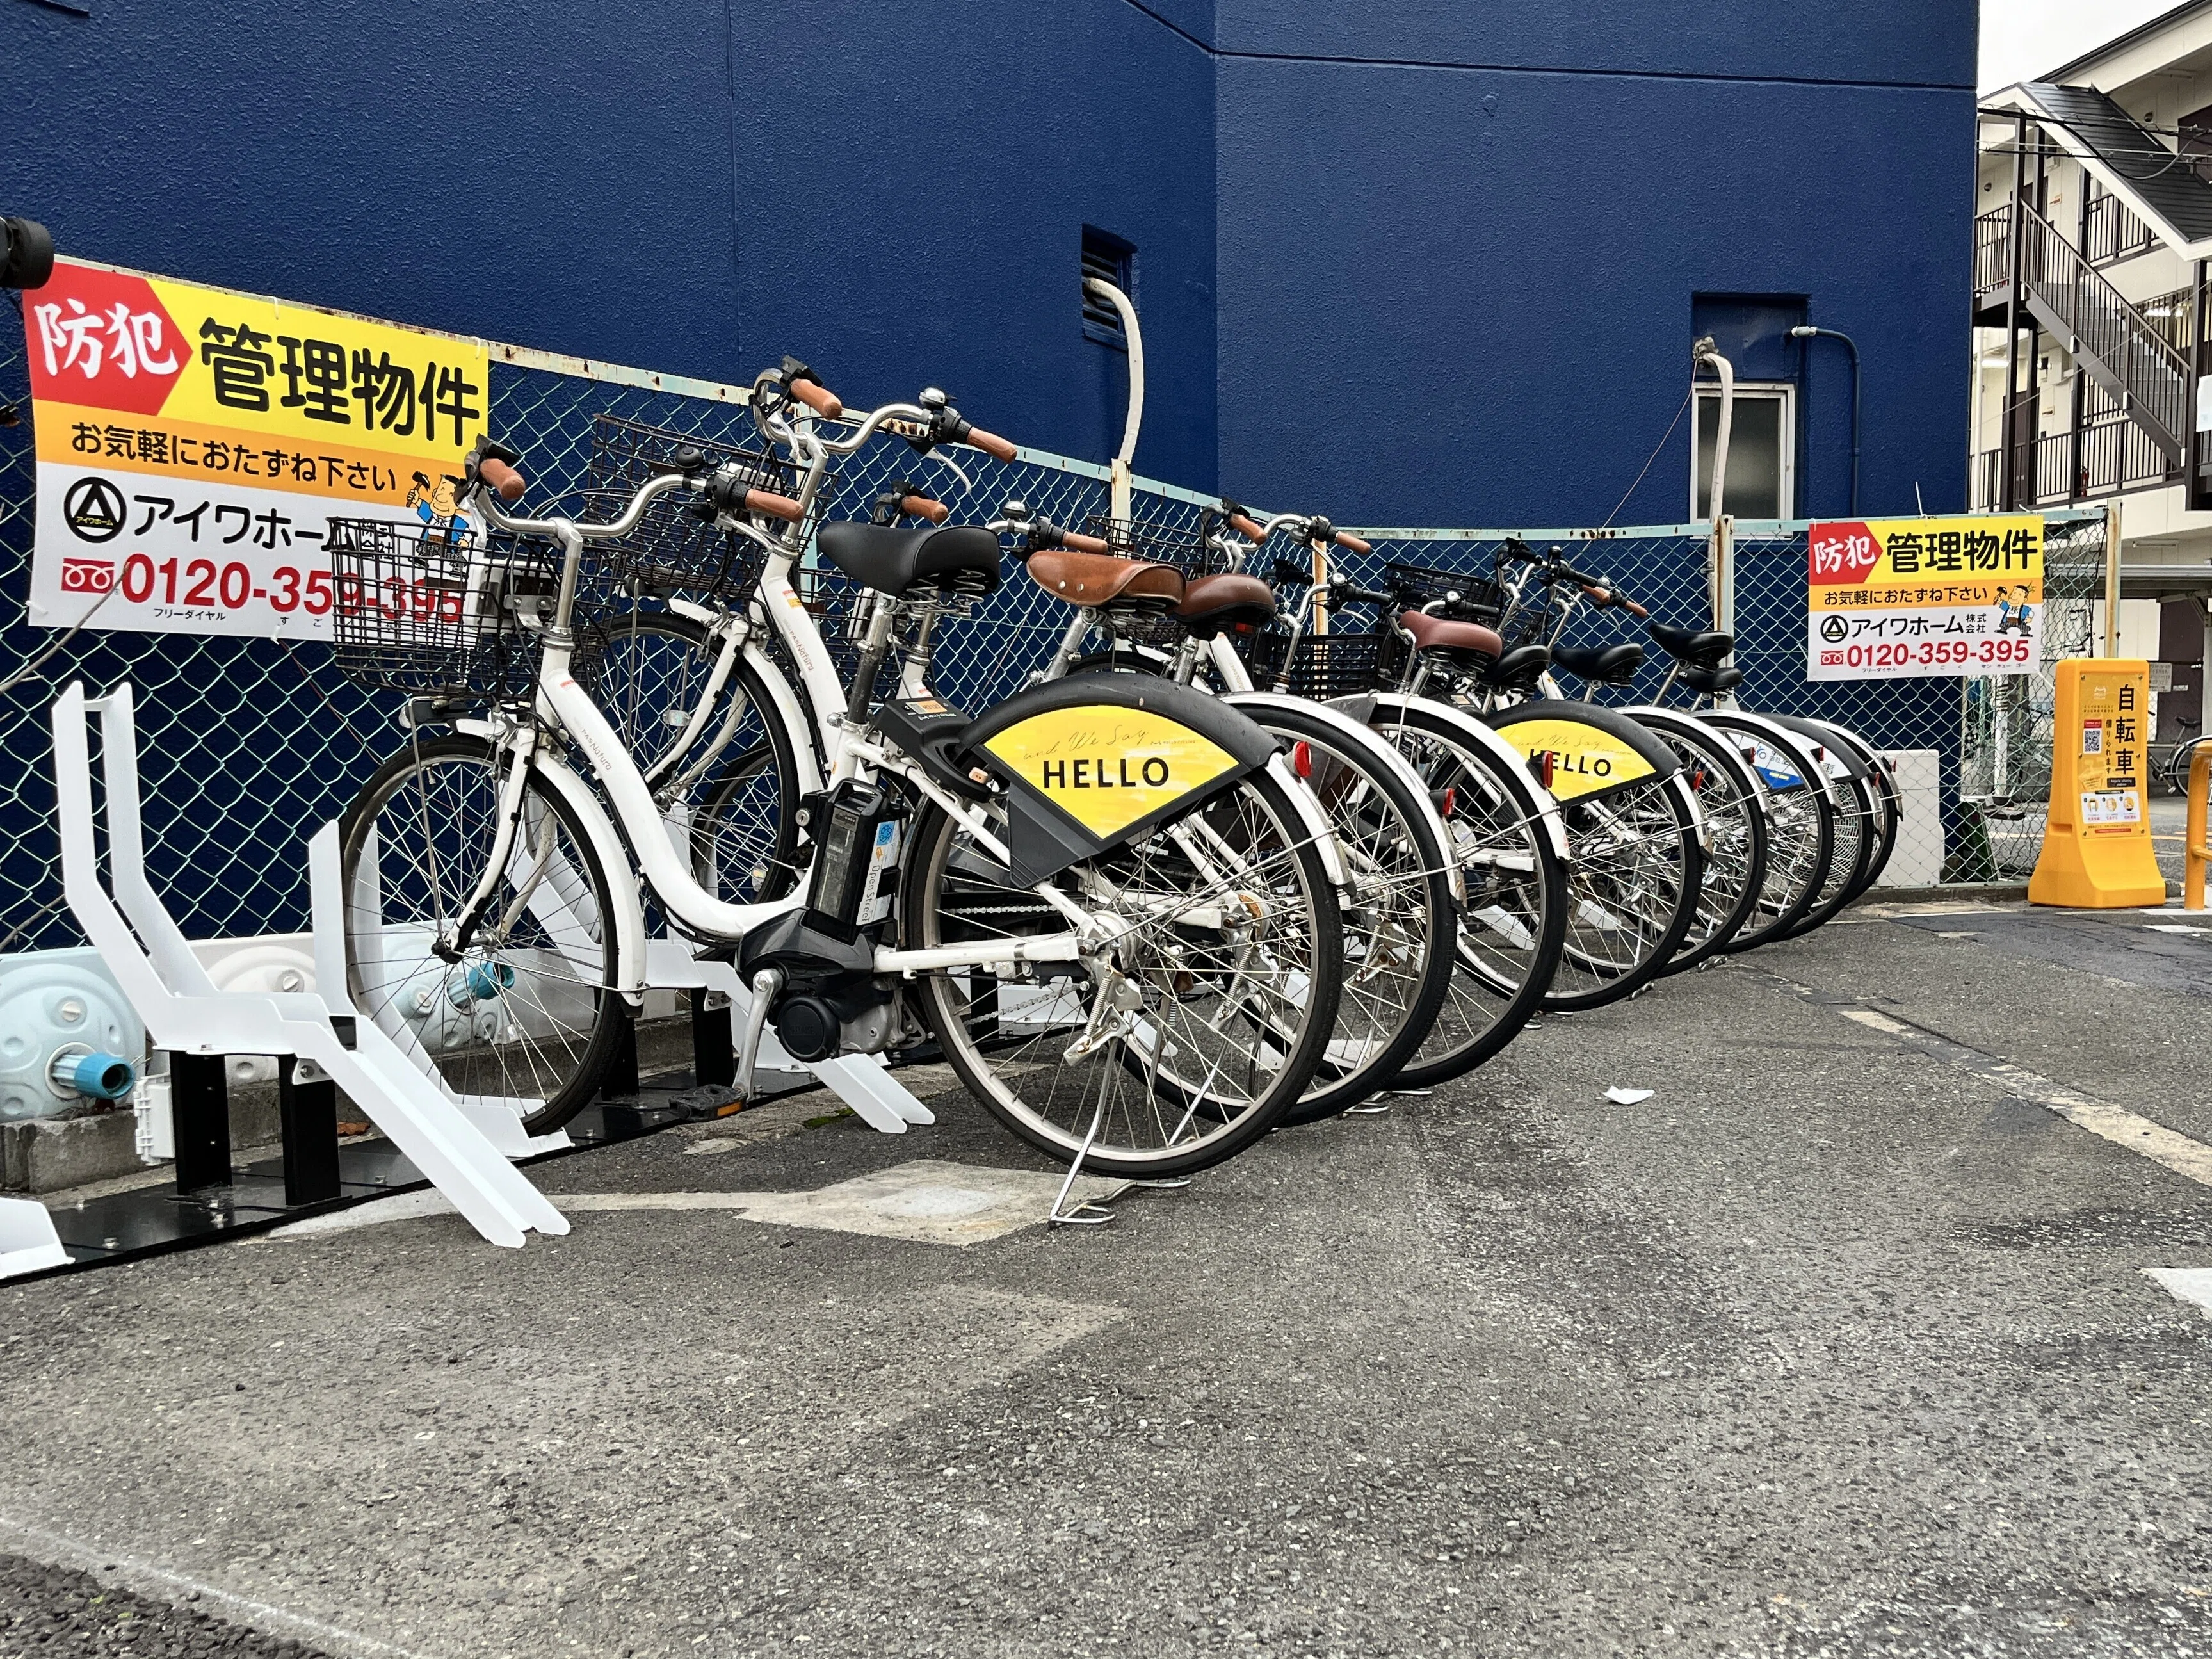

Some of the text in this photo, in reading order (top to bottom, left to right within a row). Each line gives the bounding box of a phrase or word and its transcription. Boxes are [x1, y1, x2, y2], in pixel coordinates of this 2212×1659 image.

[34, 298, 179, 380] 防犯
[200, 317, 480, 447] 管理物件
[71, 421, 396, 493] お気軽におたずね下さい
[76, 515, 113, 526] アイワホーム
[134, 494, 357, 551] アイワホーム
[1813, 535, 1877, 575] 防犯
[1886, 528, 2038, 573] 管理物件
[1824, 587, 1988, 606] お気軽におたずね下さい
[154, 608, 226, 620] フリーダイヤル
[1851, 615, 1964, 638] アイワホーム
[1966, 613, 1987, 623] 株式
[1966, 624, 1987, 634] 会社
[1846, 640, 2029, 667] 0120-359-395
[1023, 724, 1149, 760] and We Say
[2115, 684, 2136, 775] 自転車
[1043, 757, 1170, 789] HELLO
